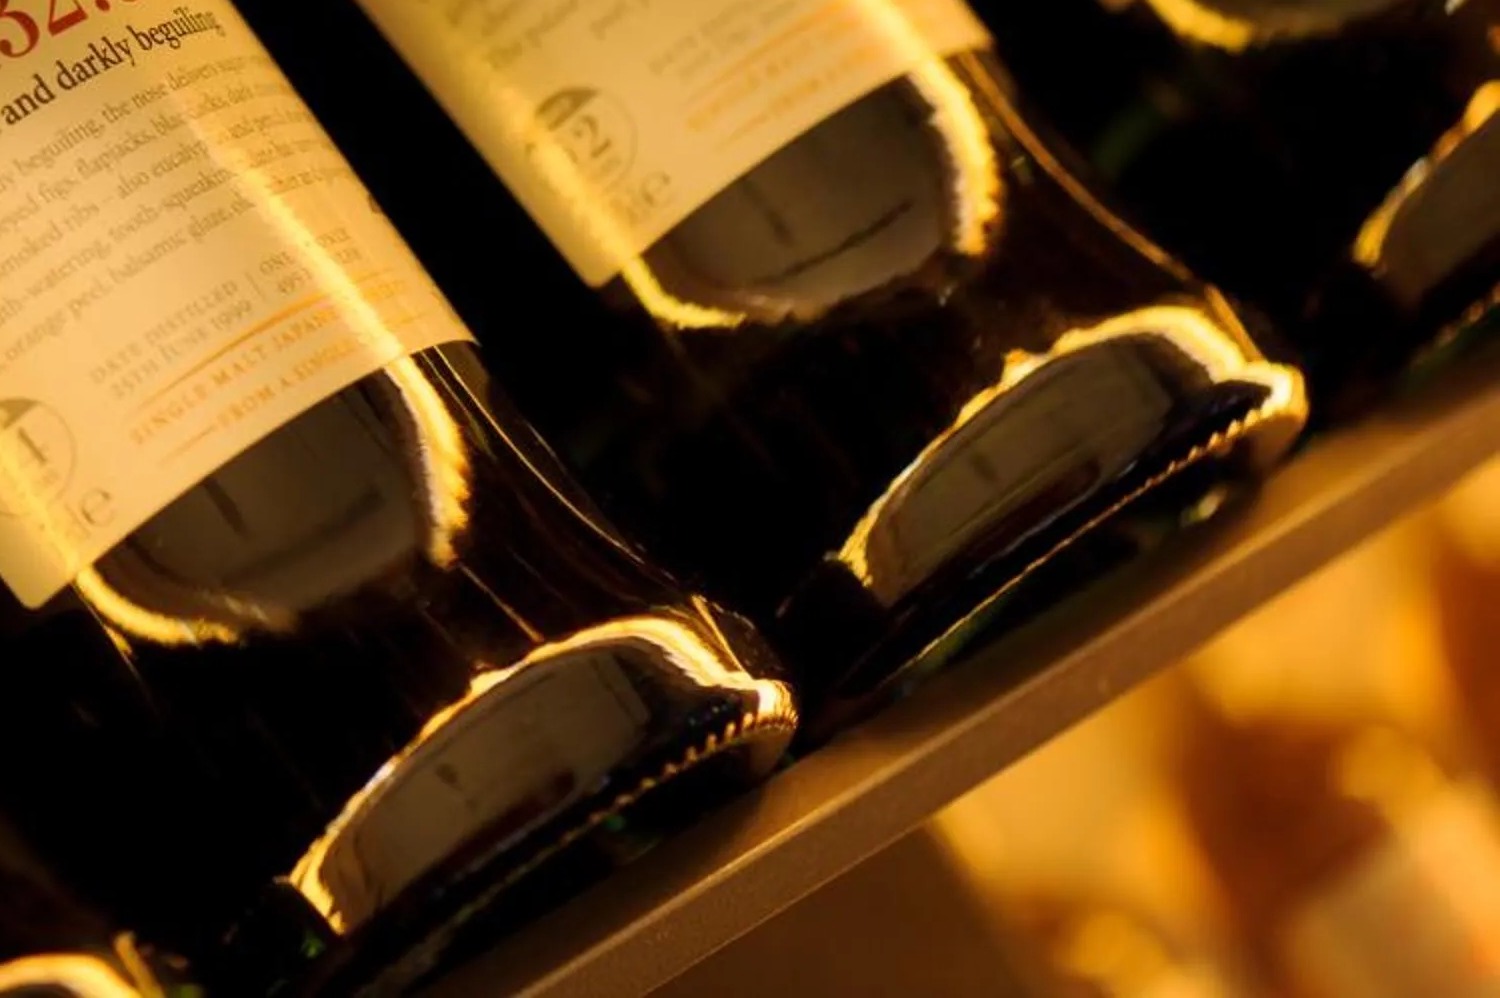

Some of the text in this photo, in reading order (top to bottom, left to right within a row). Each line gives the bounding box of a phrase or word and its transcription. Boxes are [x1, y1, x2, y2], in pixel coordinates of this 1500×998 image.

[1, 74, 56, 127] and
[56, 30, 135, 92] darkly
[134, 4, 222, 53] beguiling
[11, 126, 104, 177] beguiling,
[100, 100, 130, 125] the
